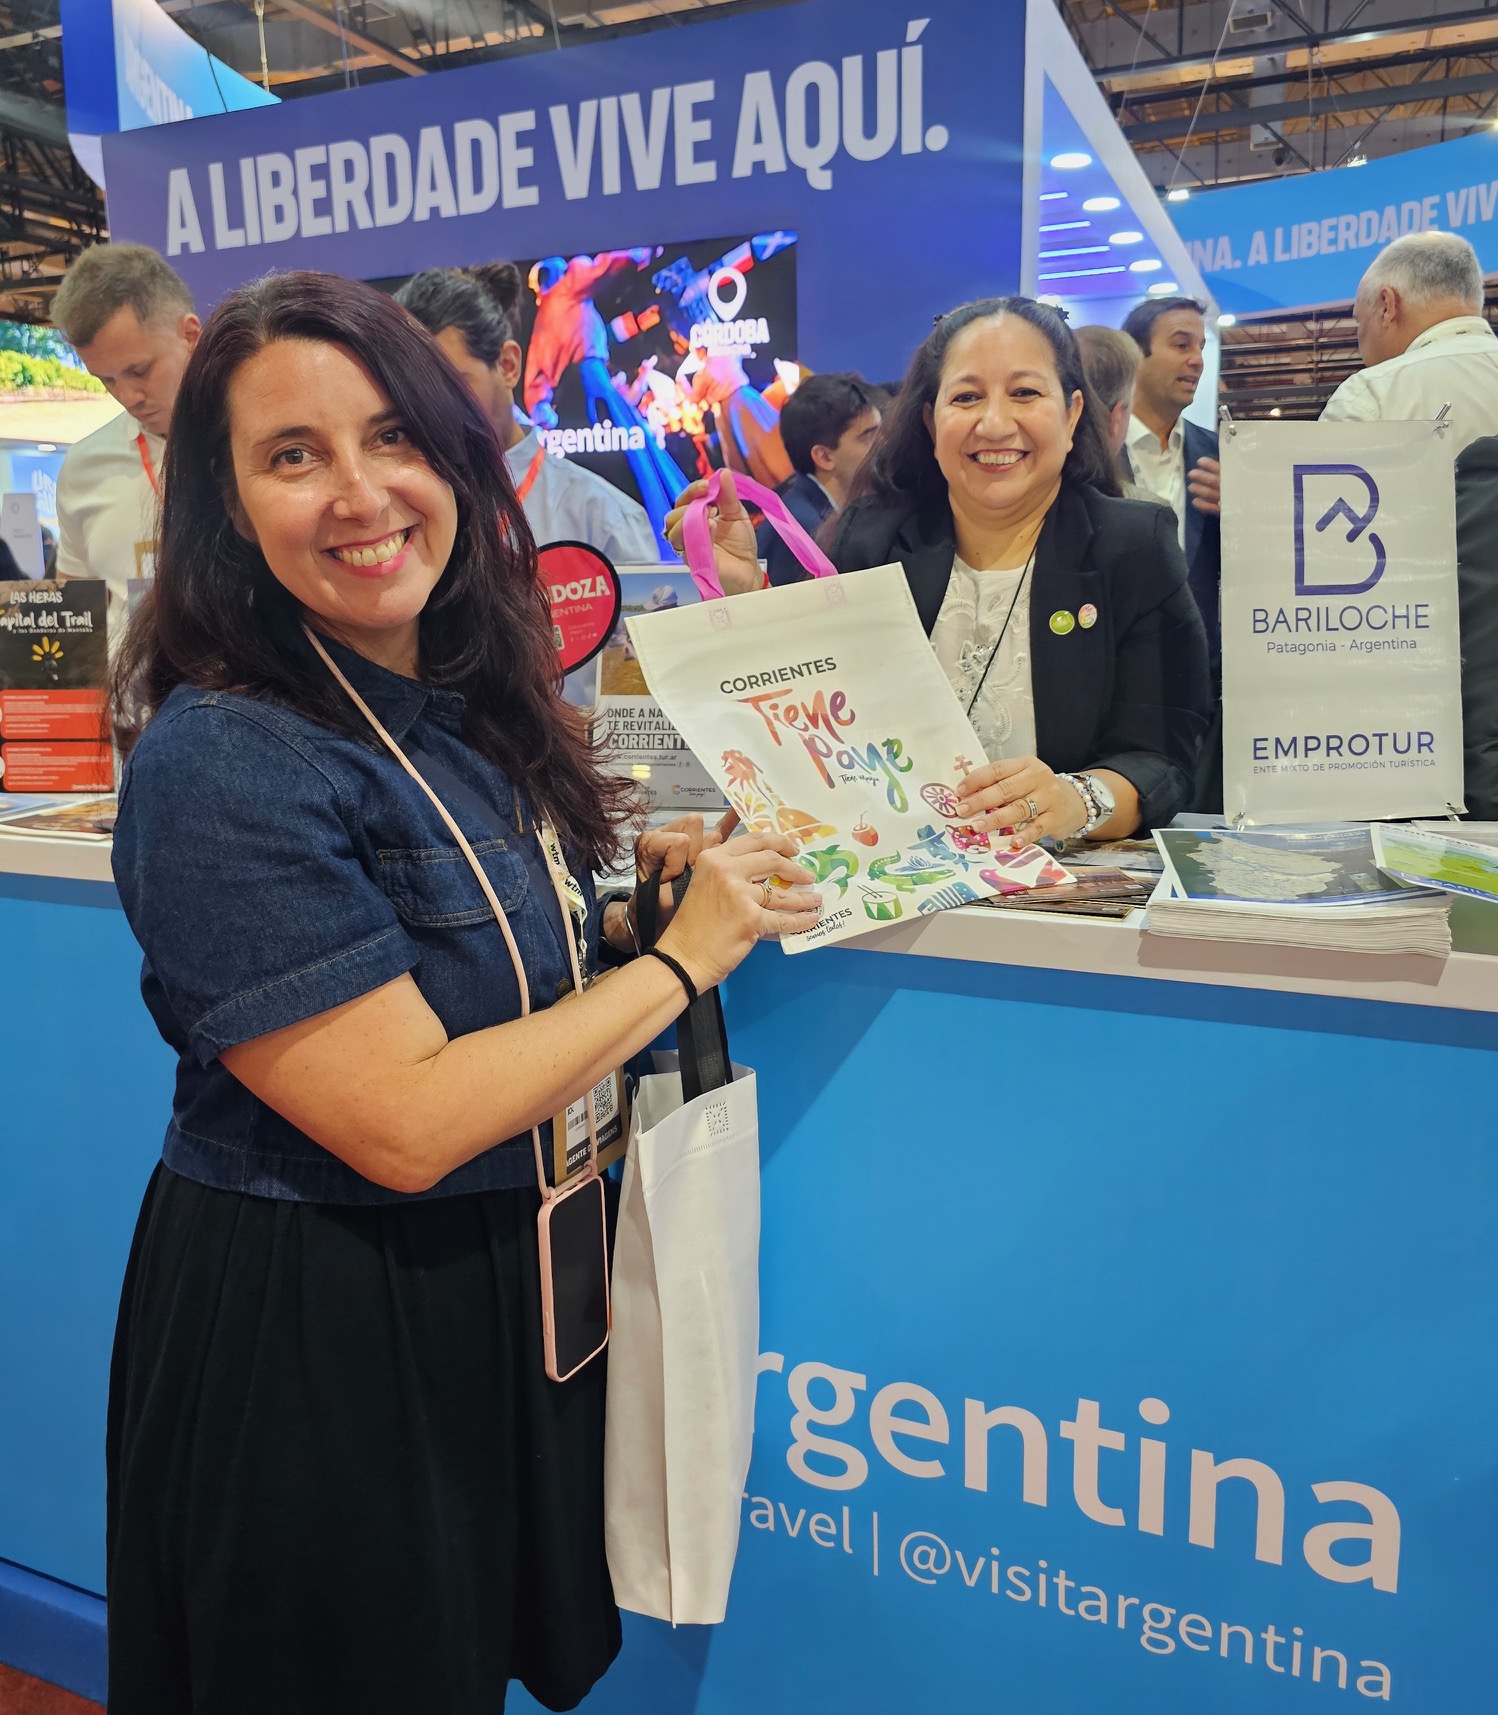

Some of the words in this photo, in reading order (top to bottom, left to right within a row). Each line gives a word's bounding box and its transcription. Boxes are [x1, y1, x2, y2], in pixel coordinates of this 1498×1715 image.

[166, 166, 205, 256] A
[208, 109, 540, 251] LIBERDADE
[548, 79, 717, 201] VIVE
[731, 17, 950, 191] AQUÍ.
[1247, 230, 1269, 267] A
[1273, 195, 1441, 262] LIBERDADE
[9, 591, 27, 604] LAS
[549, 575, 611, 604] DOZA
[37, 609, 59, 628] del
[60, 610, 94, 628] Trail
[1252, 603, 1430, 634] BARILOCHE
[1266, 640, 1336, 655] Patagonia
[1349, 637, 1417, 653] Argentina
[719, 656, 838, 695] CORRIENTES
[638, 708, 646, 718] A
[731, 688, 856, 747] Tiene
[1252, 731, 1435, 761] EMPROTUR
[1252, 764, 1278, 774] ENTE
[1280, 764, 1310, 773] MIXTO
[1312, 763, 1326, 772] DE
[1328, 759, 1386, 771] PROMOCIÓN
[1388, 758, 1437, 769] TURÍSTICA
[550, 843, 561, 866] wtm
[564, 878, 583, 896] wtm
[742, 1492, 853, 1554] avel
[899, 1530, 1393, 1702] @visitargentina
